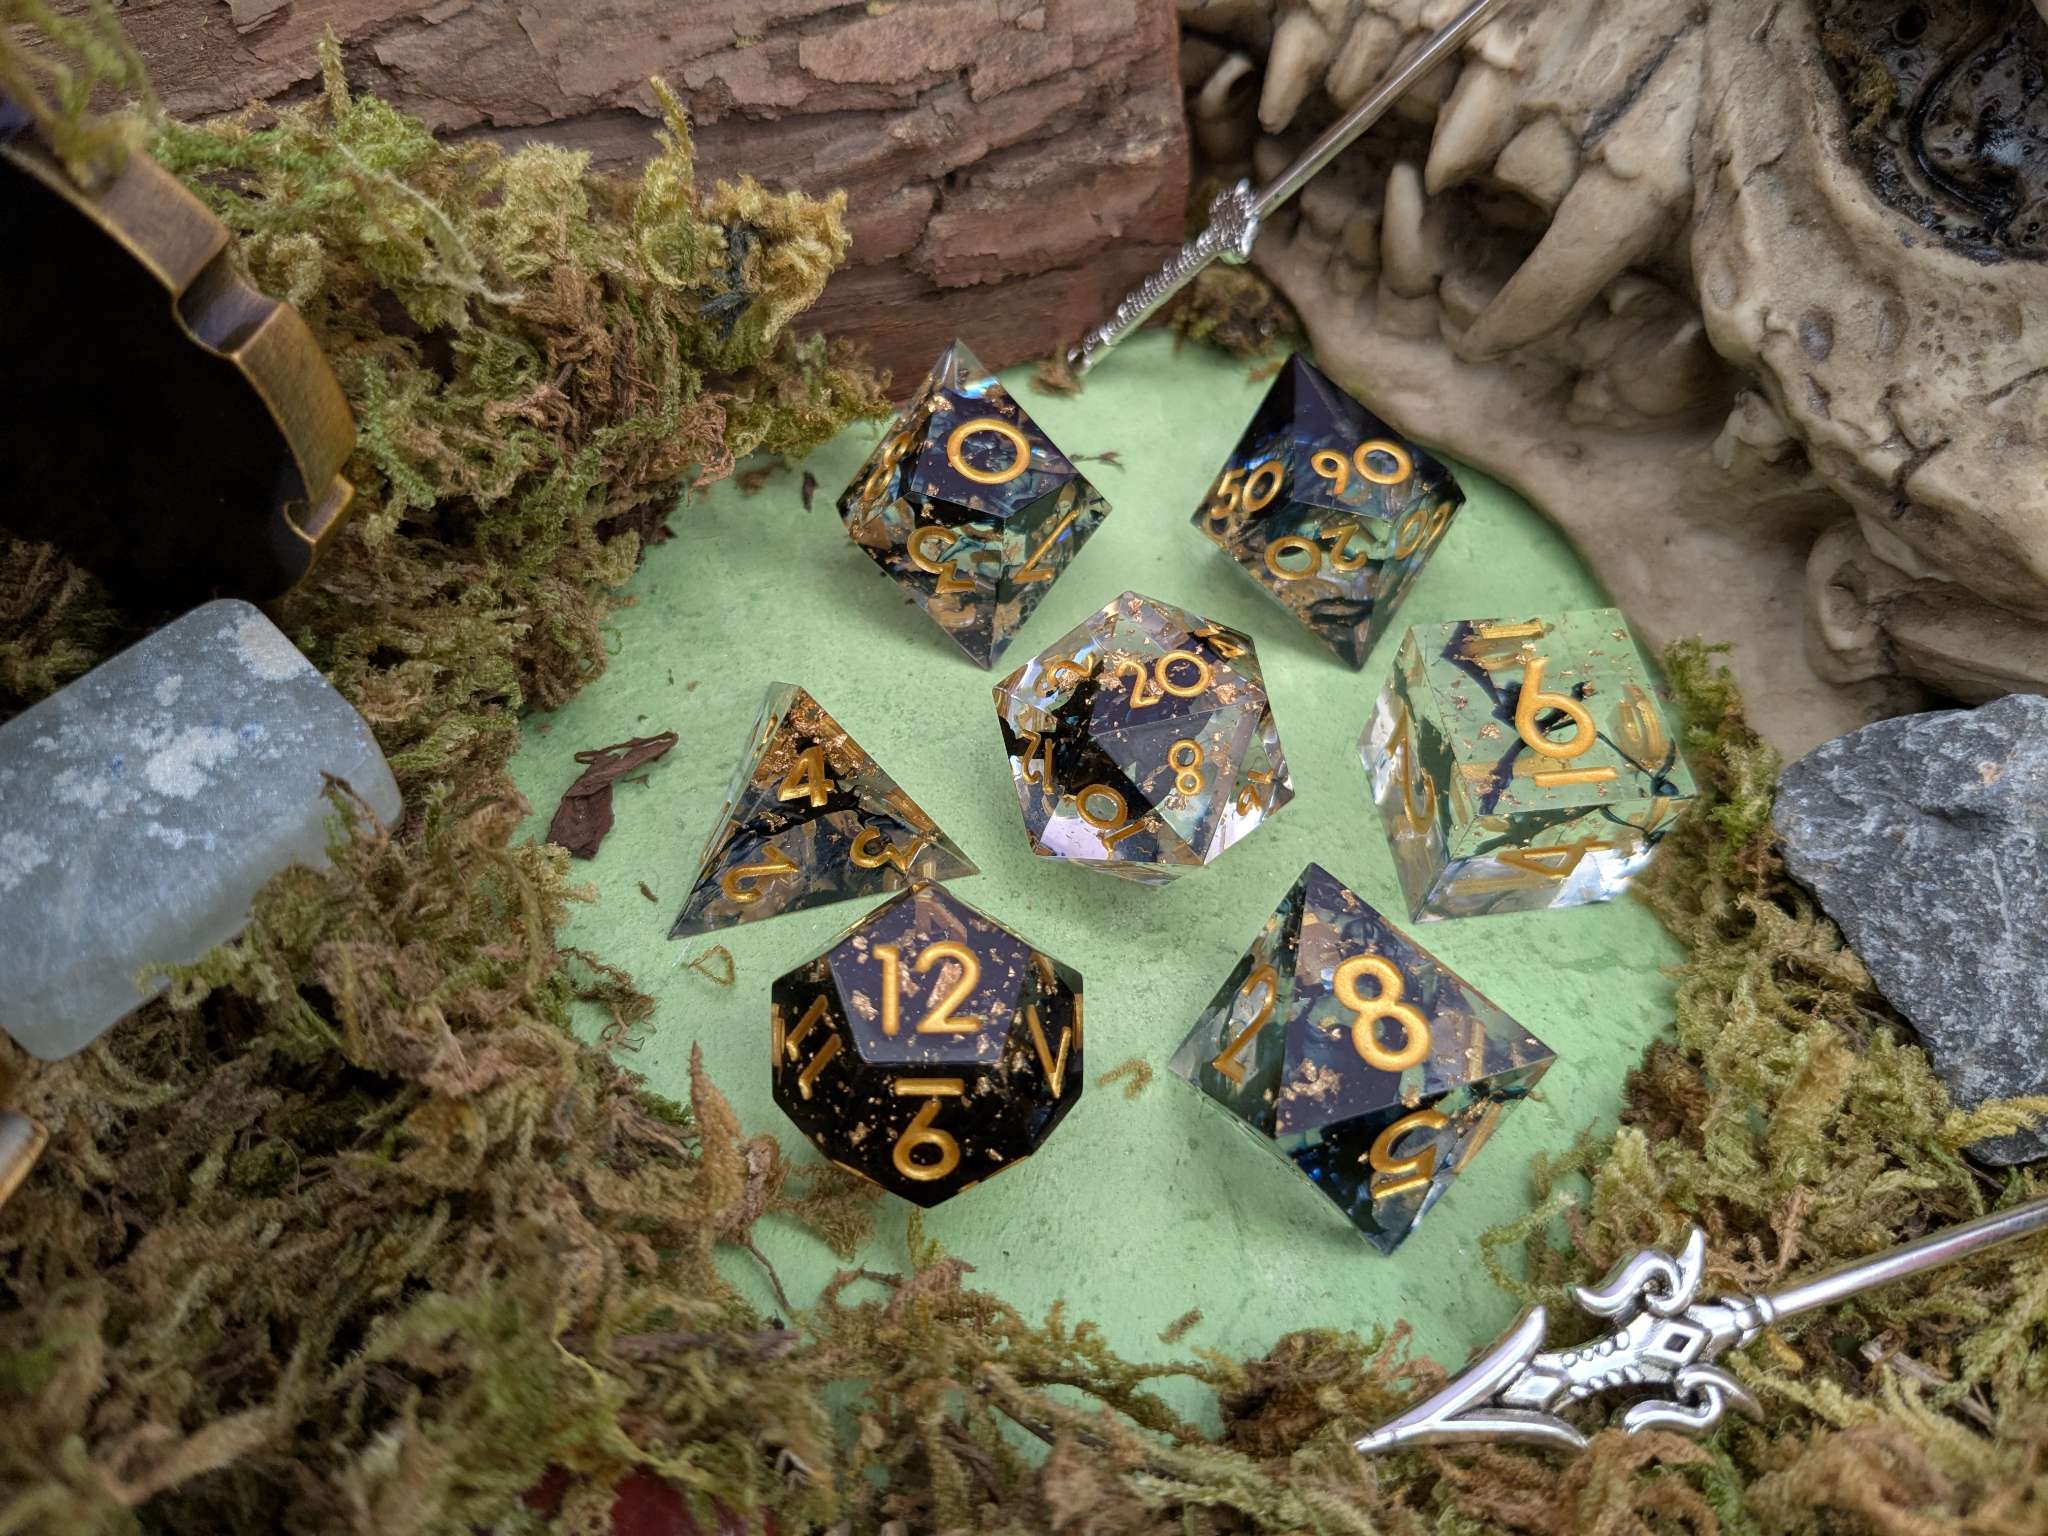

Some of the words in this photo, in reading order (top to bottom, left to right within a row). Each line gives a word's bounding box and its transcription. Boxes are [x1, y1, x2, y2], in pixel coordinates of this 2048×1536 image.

[1210, 460, 1284, 519] 50
[1311, 438, 1413, 496] 90
[1264, 522, 1368, 580] 20
[1116, 649, 1210, 709] 20
[1515, 656, 1597, 759] 6
[778, 745, 835, 808] 4
[1168, 739, 1205, 796] 8
[873, 940, 982, 1036] 12
[1333, 954, 1432, 1072] 8
